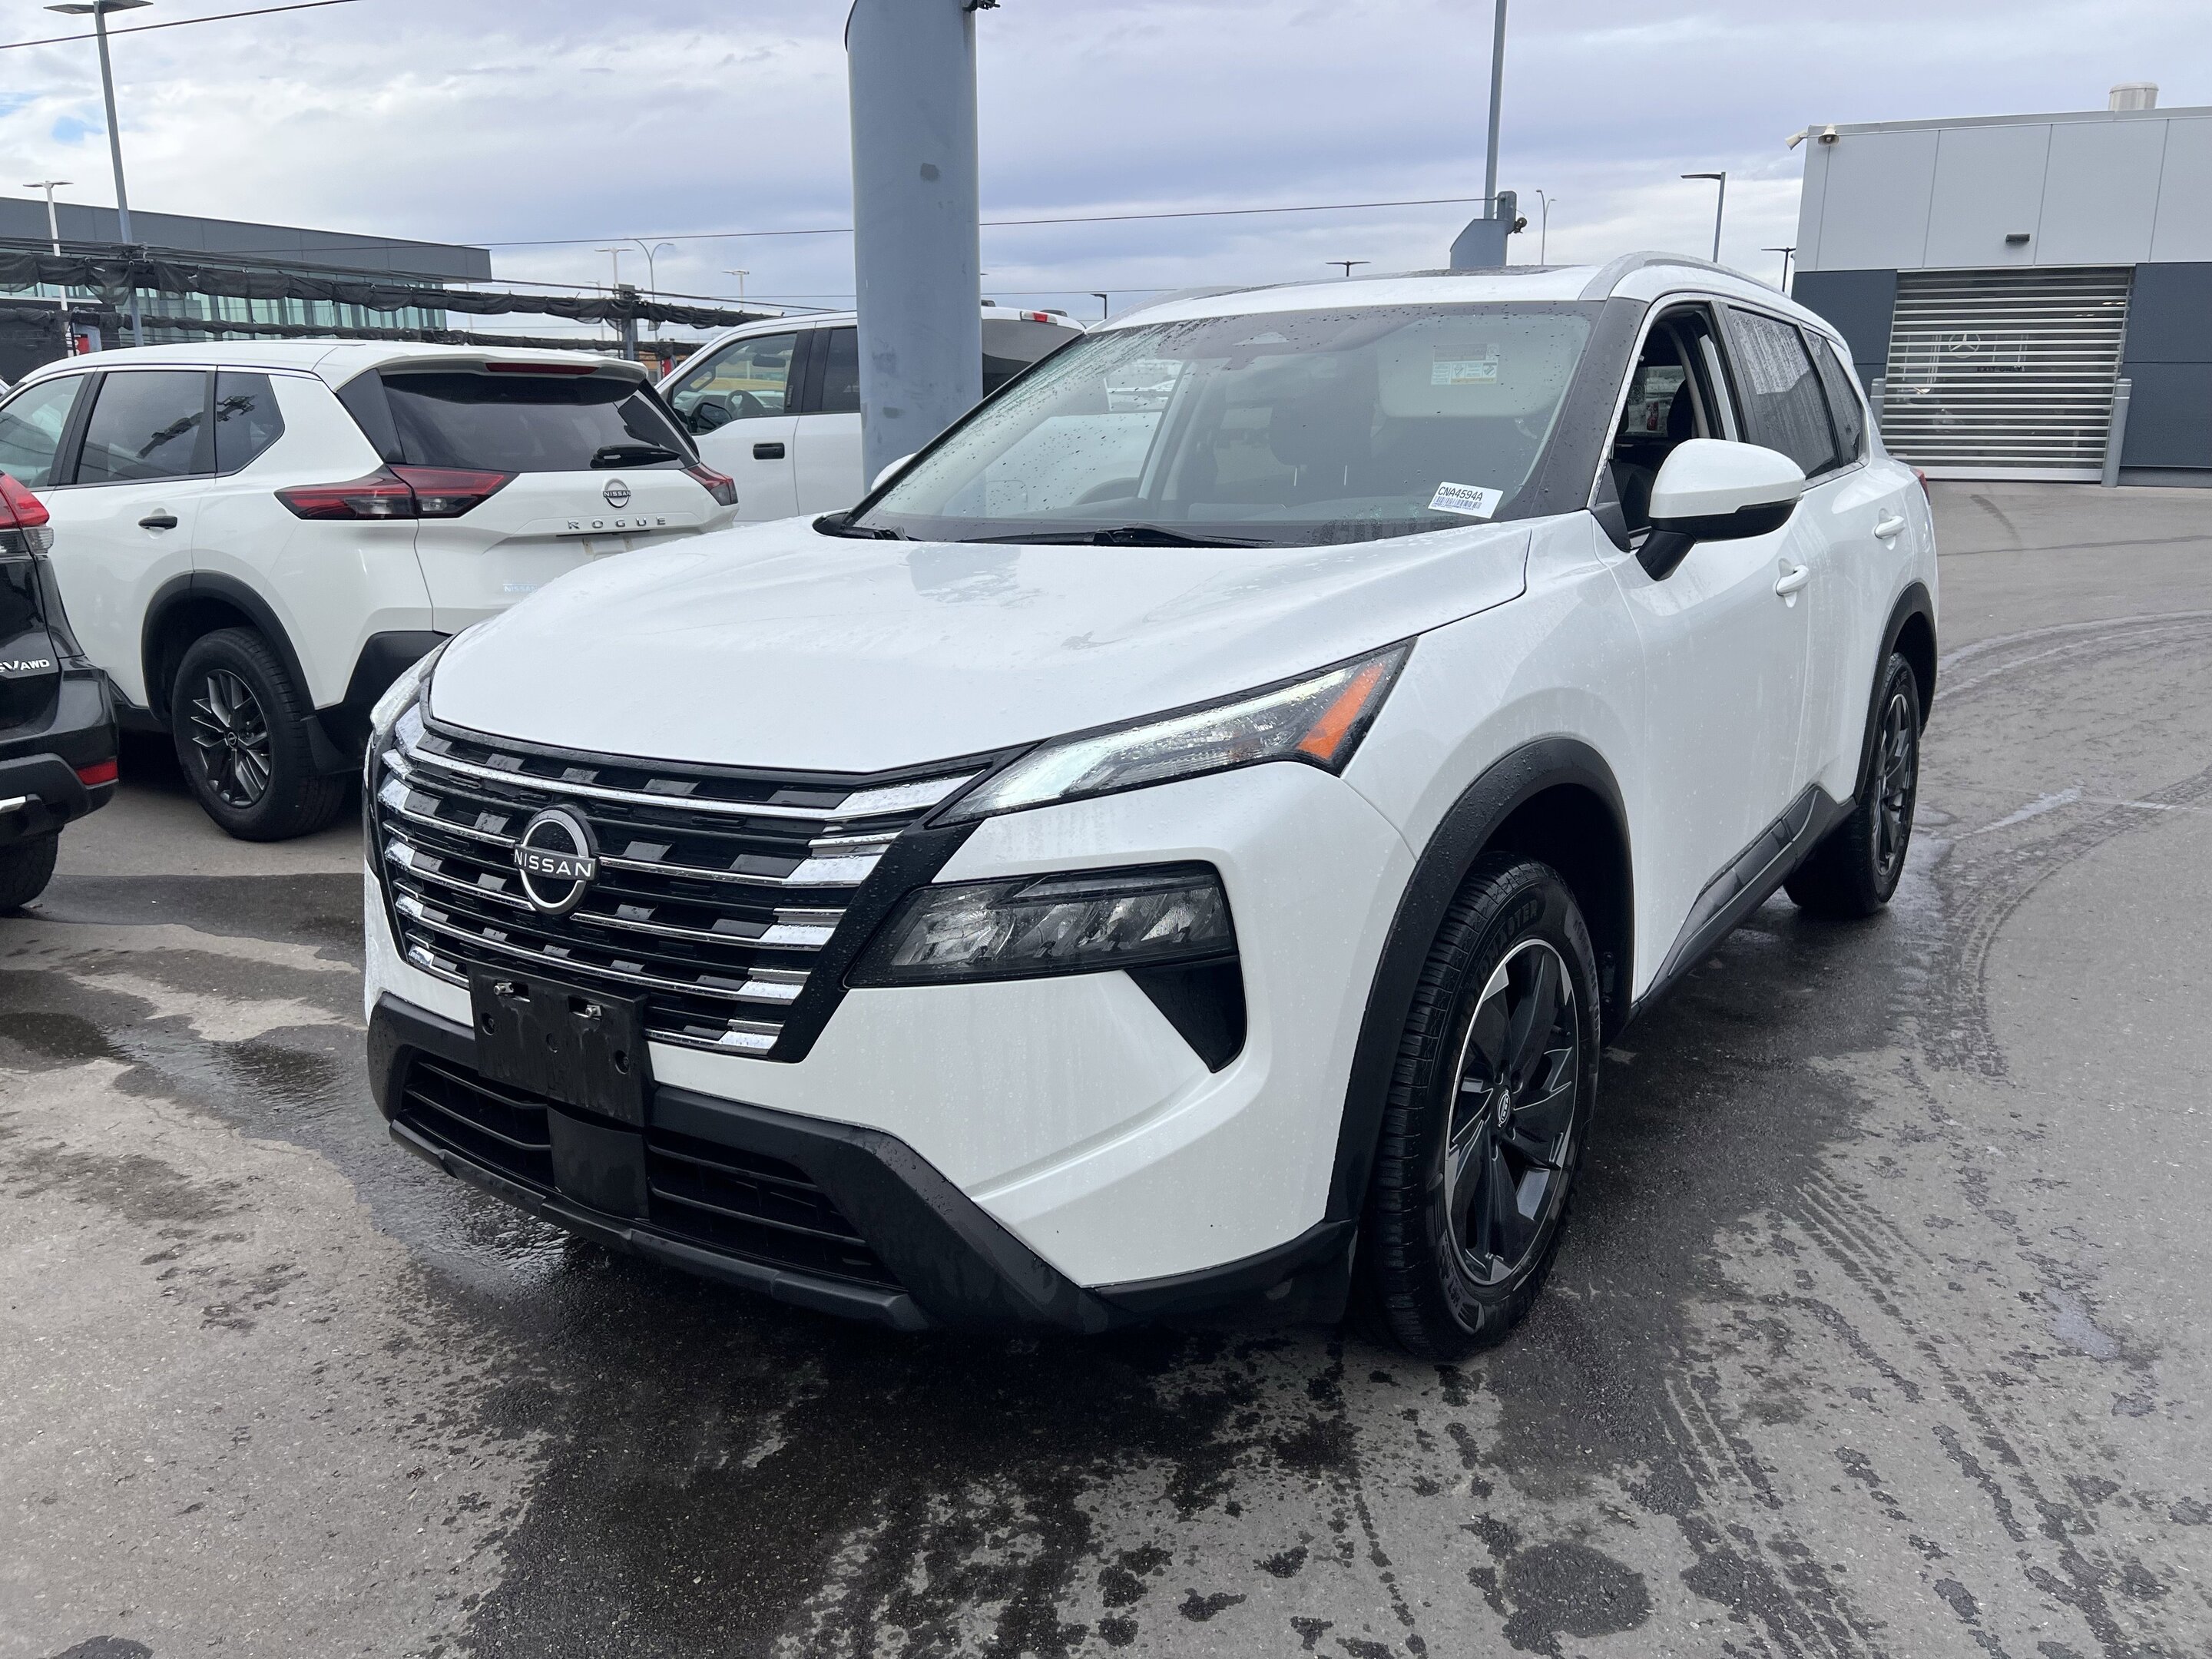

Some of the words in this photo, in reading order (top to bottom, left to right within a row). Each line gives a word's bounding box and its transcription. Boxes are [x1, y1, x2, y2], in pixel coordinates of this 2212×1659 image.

[1438, 486, 1483, 502] CNA4594A
[568, 516, 666, 530] ROGUE
[20, 659, 50, 671] AWD
[514, 849, 591, 877] NISSAN
